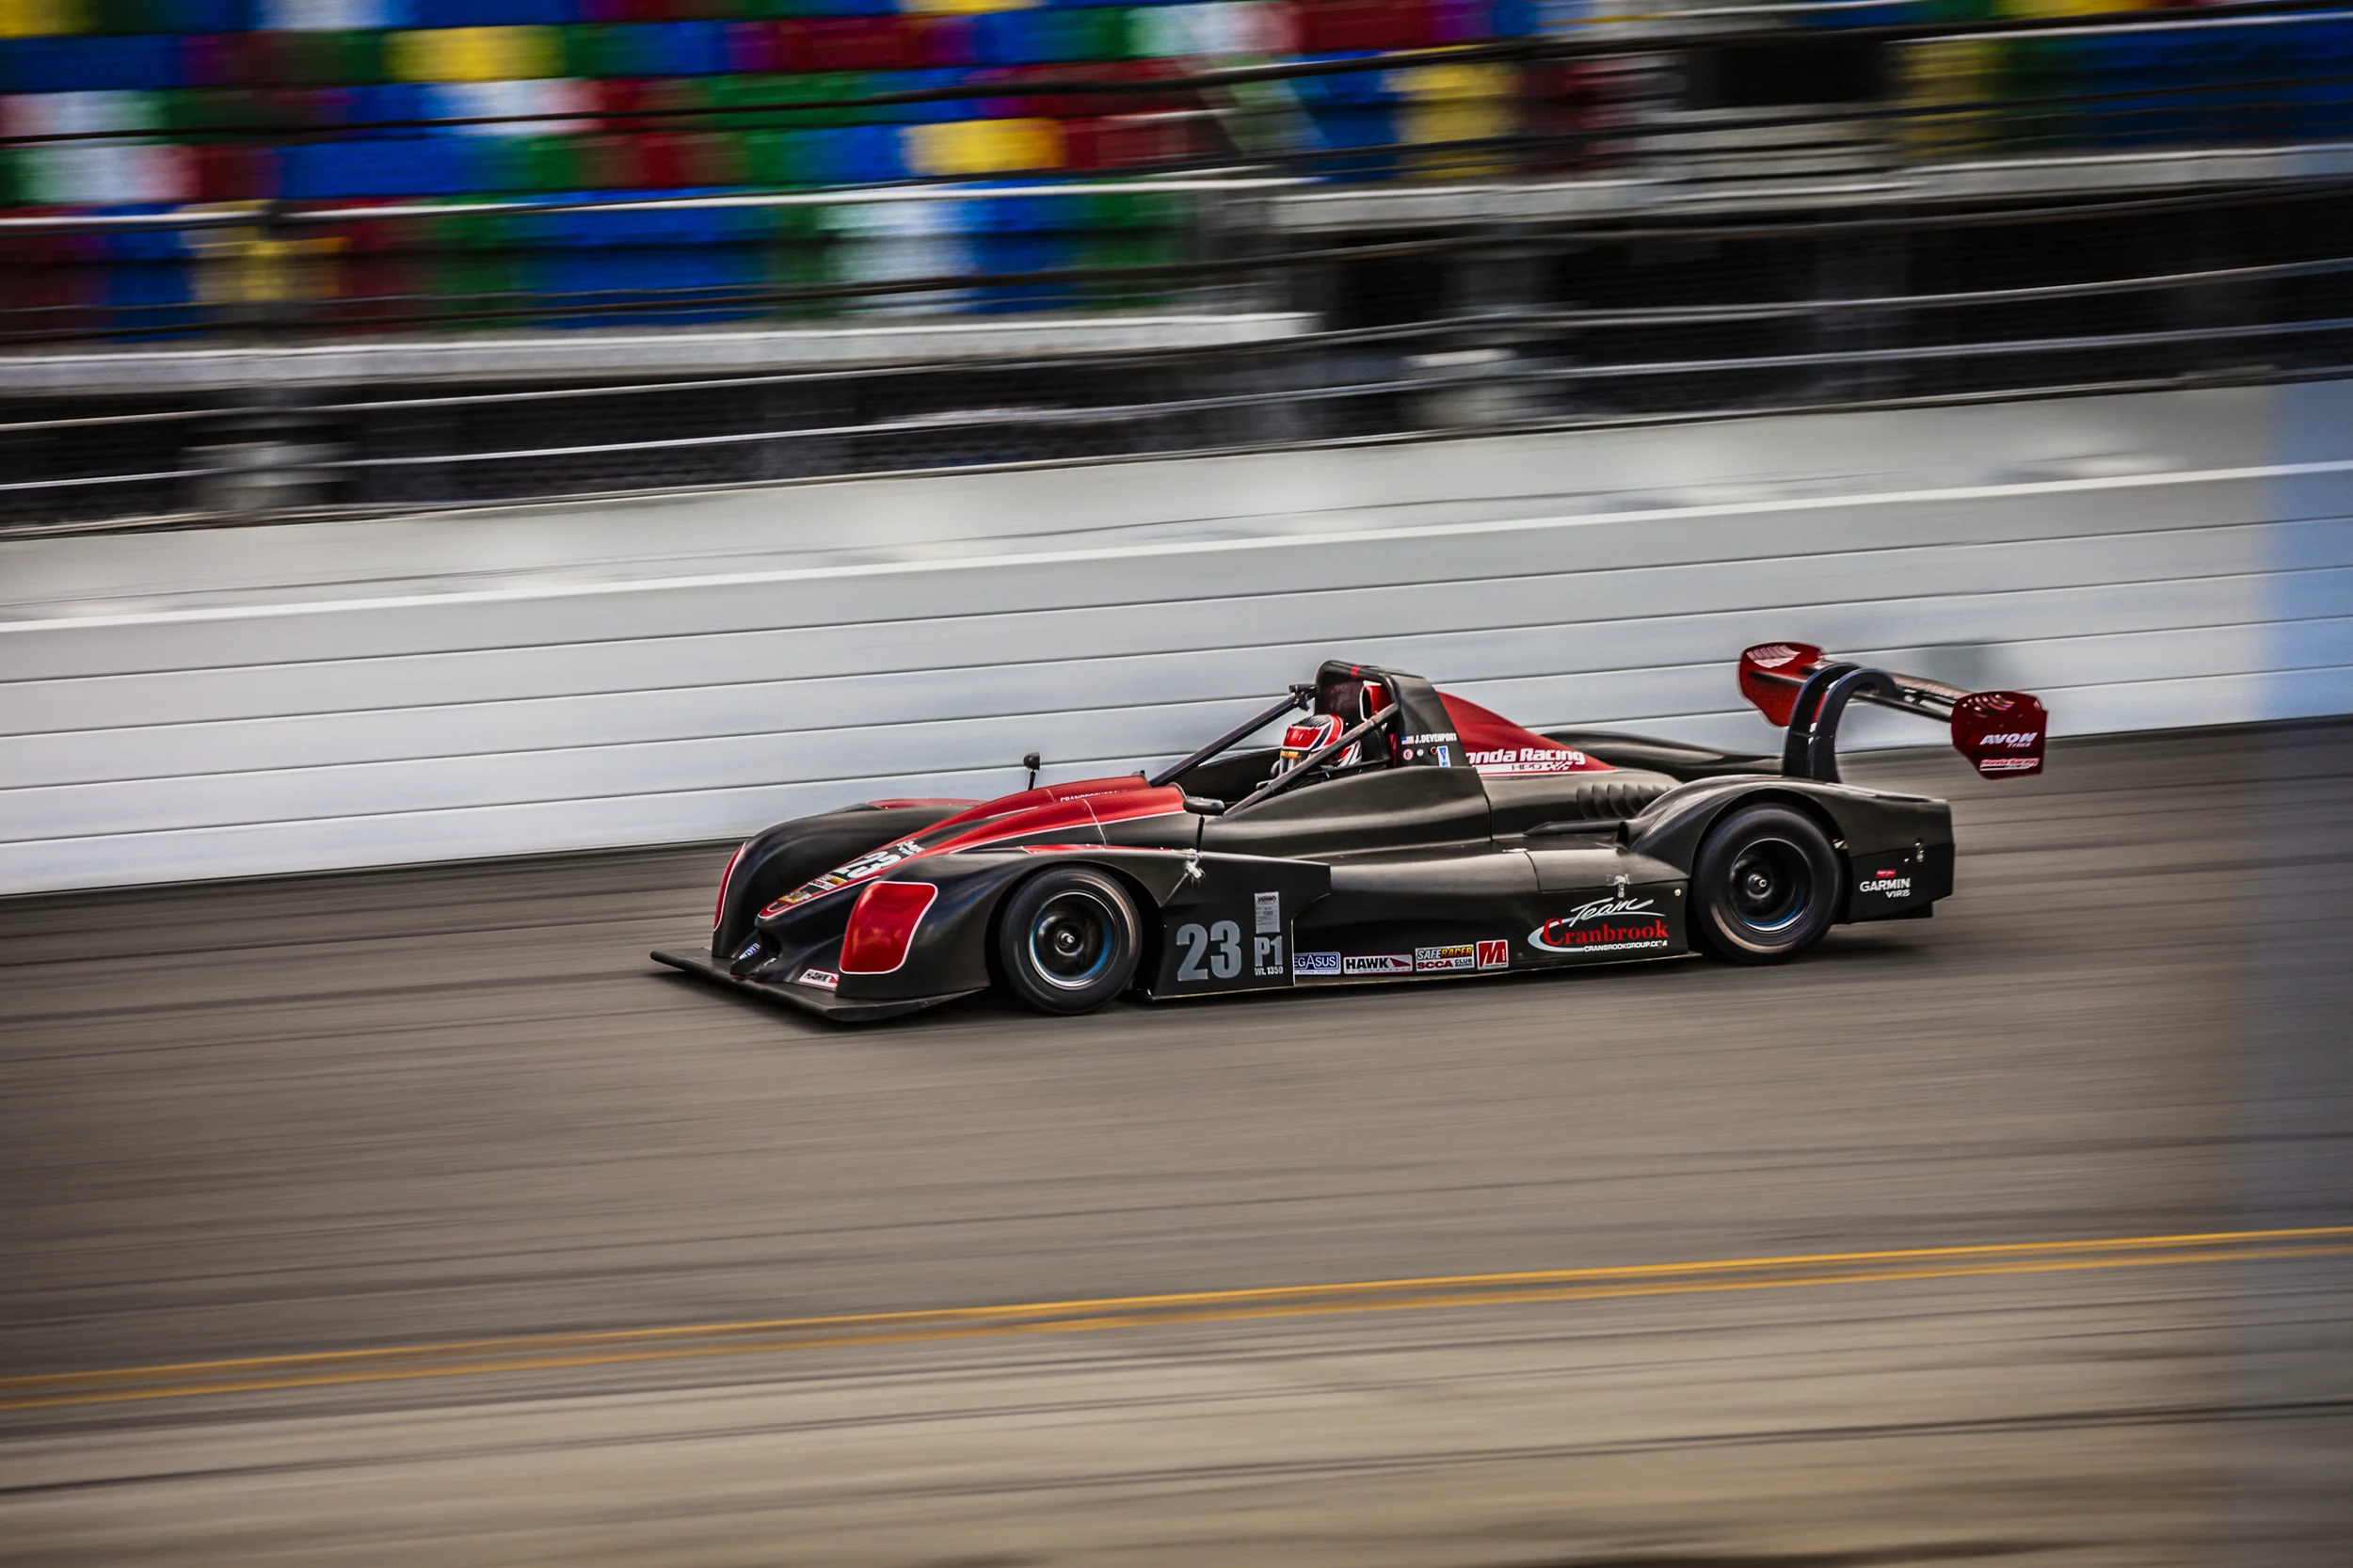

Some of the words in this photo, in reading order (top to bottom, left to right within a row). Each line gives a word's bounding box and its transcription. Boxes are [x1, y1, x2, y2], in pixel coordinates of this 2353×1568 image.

[1979, 732, 2038, 745] AVON
[1520, 748, 1585, 765] Racing
[1859, 877, 1911, 892] GARMIN
[1569, 897, 1654, 927] Team
[1543, 918, 1669, 946] Cranbrook
[1176, 920, 1242, 982] 23
[1254, 936, 1283, 968] P1
[1267, 966, 1284, 975] 1350
[1345, 957, 1389, 969] HAWK
[1417, 960, 1454, 970] SCCA
